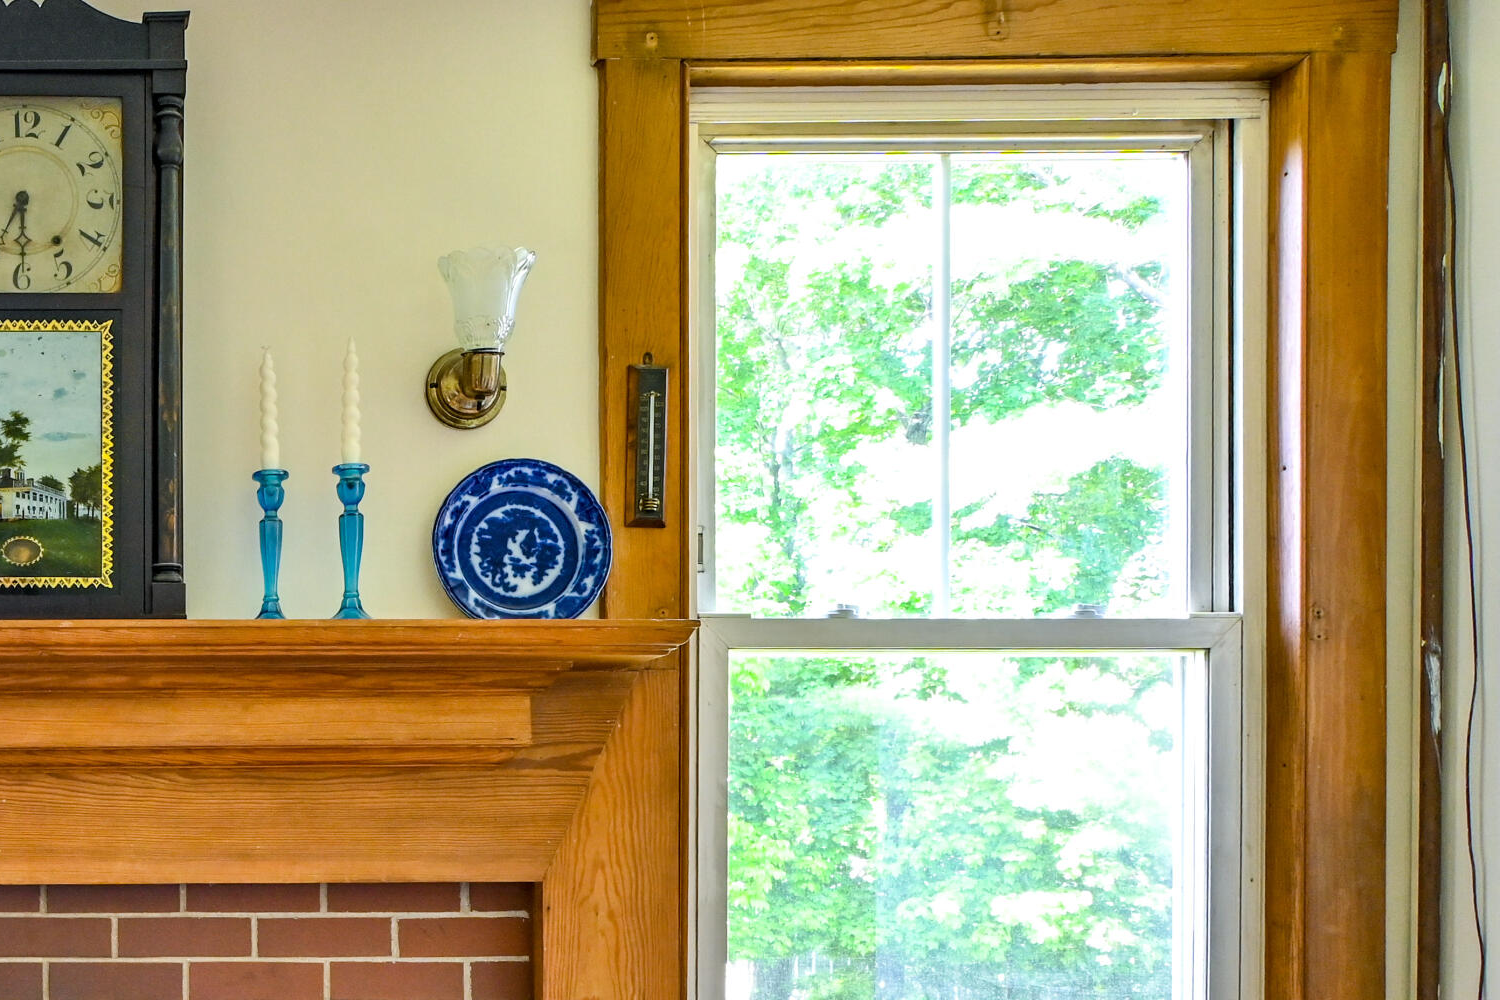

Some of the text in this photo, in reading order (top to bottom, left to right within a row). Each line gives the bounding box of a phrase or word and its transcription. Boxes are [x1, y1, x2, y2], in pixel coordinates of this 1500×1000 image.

[14, 110, 45, 139] 12
[50, 123, 73, 150] 1
[76, 151, 104, 177] 2
[86, 189, 115, 210] 3
[79, 229, 106, 252] 4
[12, 262, 32, 290] 6
[53, 248, 73, 281] 5
